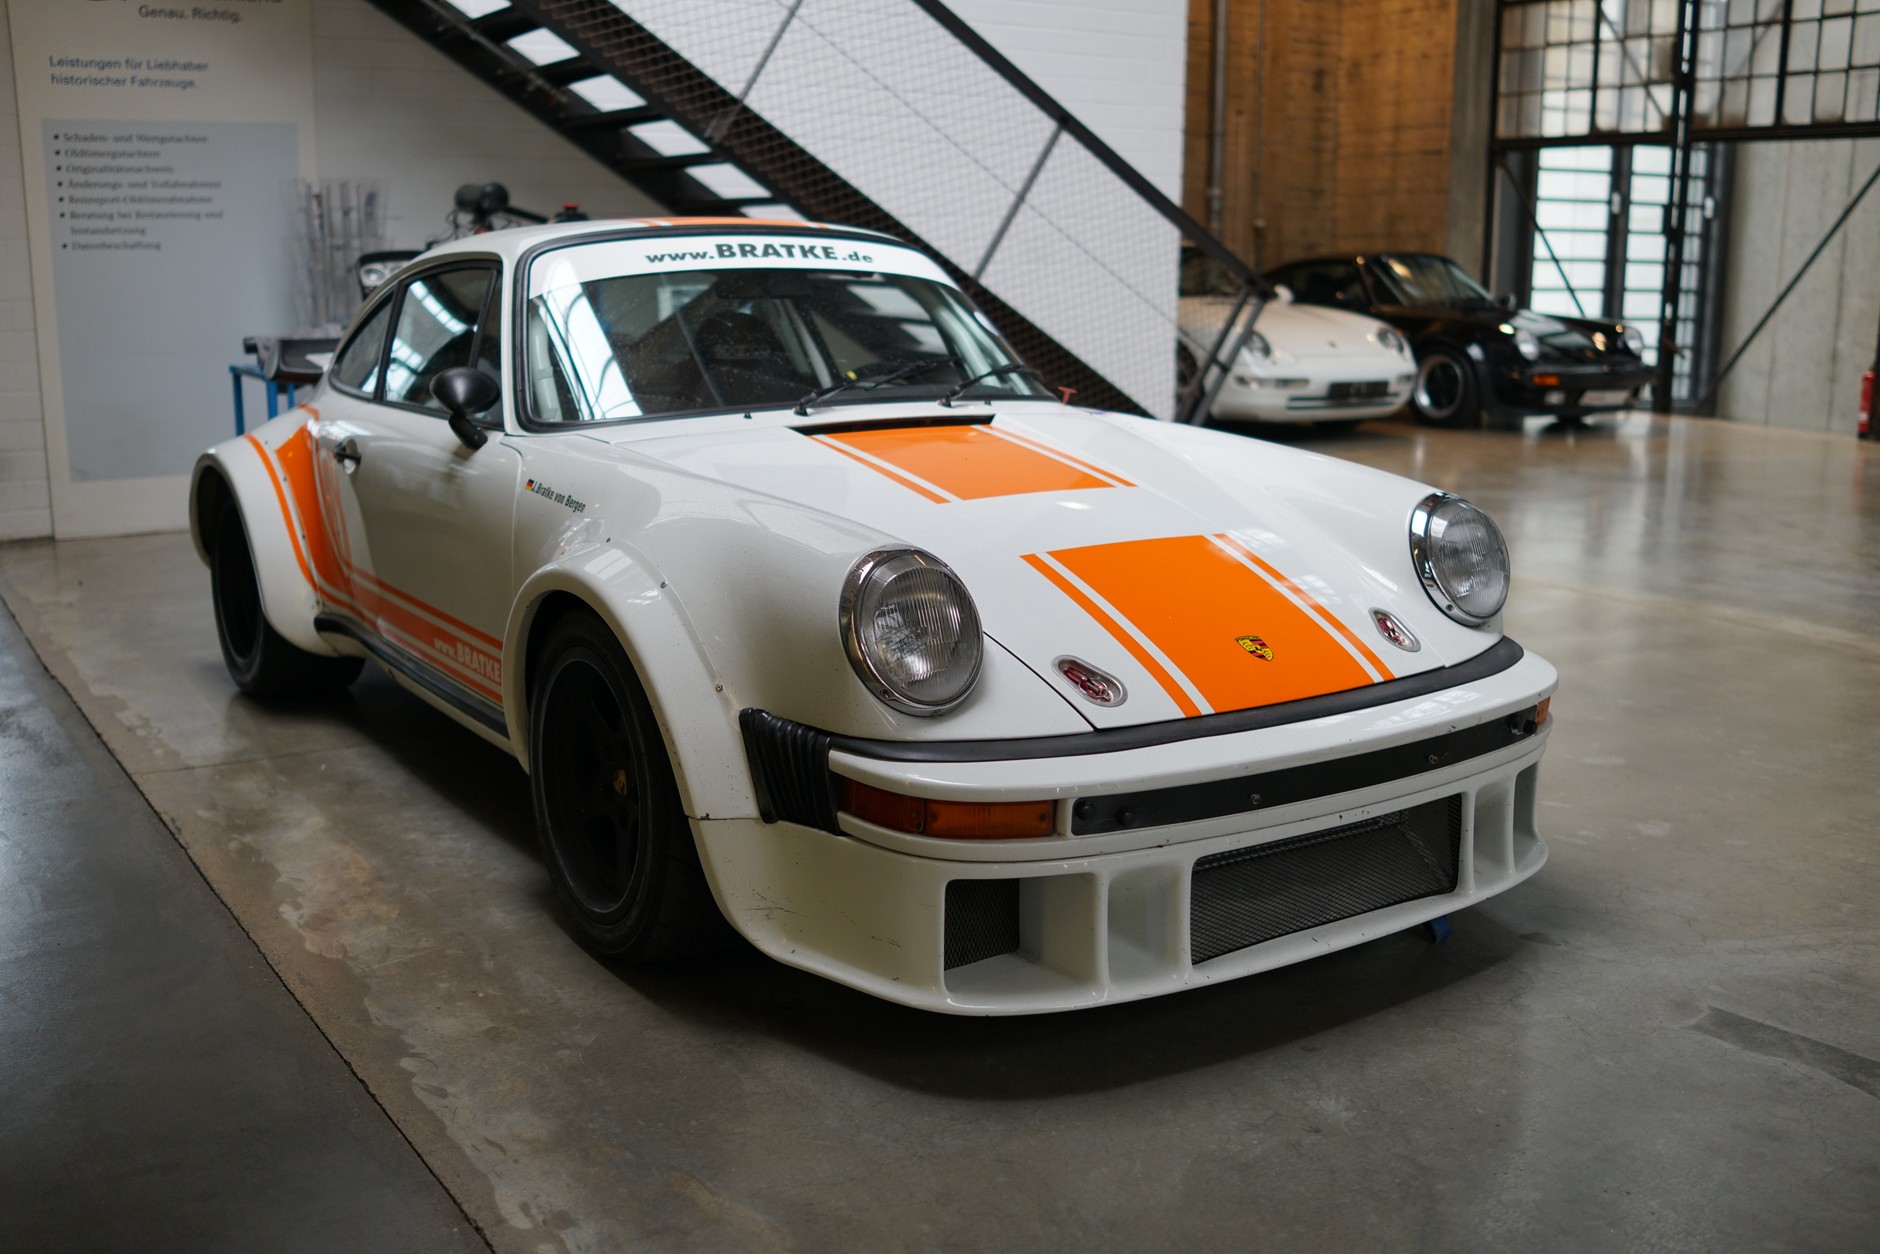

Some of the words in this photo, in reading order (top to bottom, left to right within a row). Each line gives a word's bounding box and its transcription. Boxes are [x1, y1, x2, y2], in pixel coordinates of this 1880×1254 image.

[138, 5, 188, 19] Genau.
[192, 7, 243, 23] Richtig.
[49, 56, 122, 71] Leistungen
[125, 58, 143, 70] für
[146, 60, 208, 72] Liebhaber
[50, 74, 127, 87] historischer
[130, 76, 198, 90] Fahrzeuge.
[645, 243, 874, 264] www.BRATKE.de
[554, 492, 566, 505] von
[564, 494, 587, 513] Bergen
